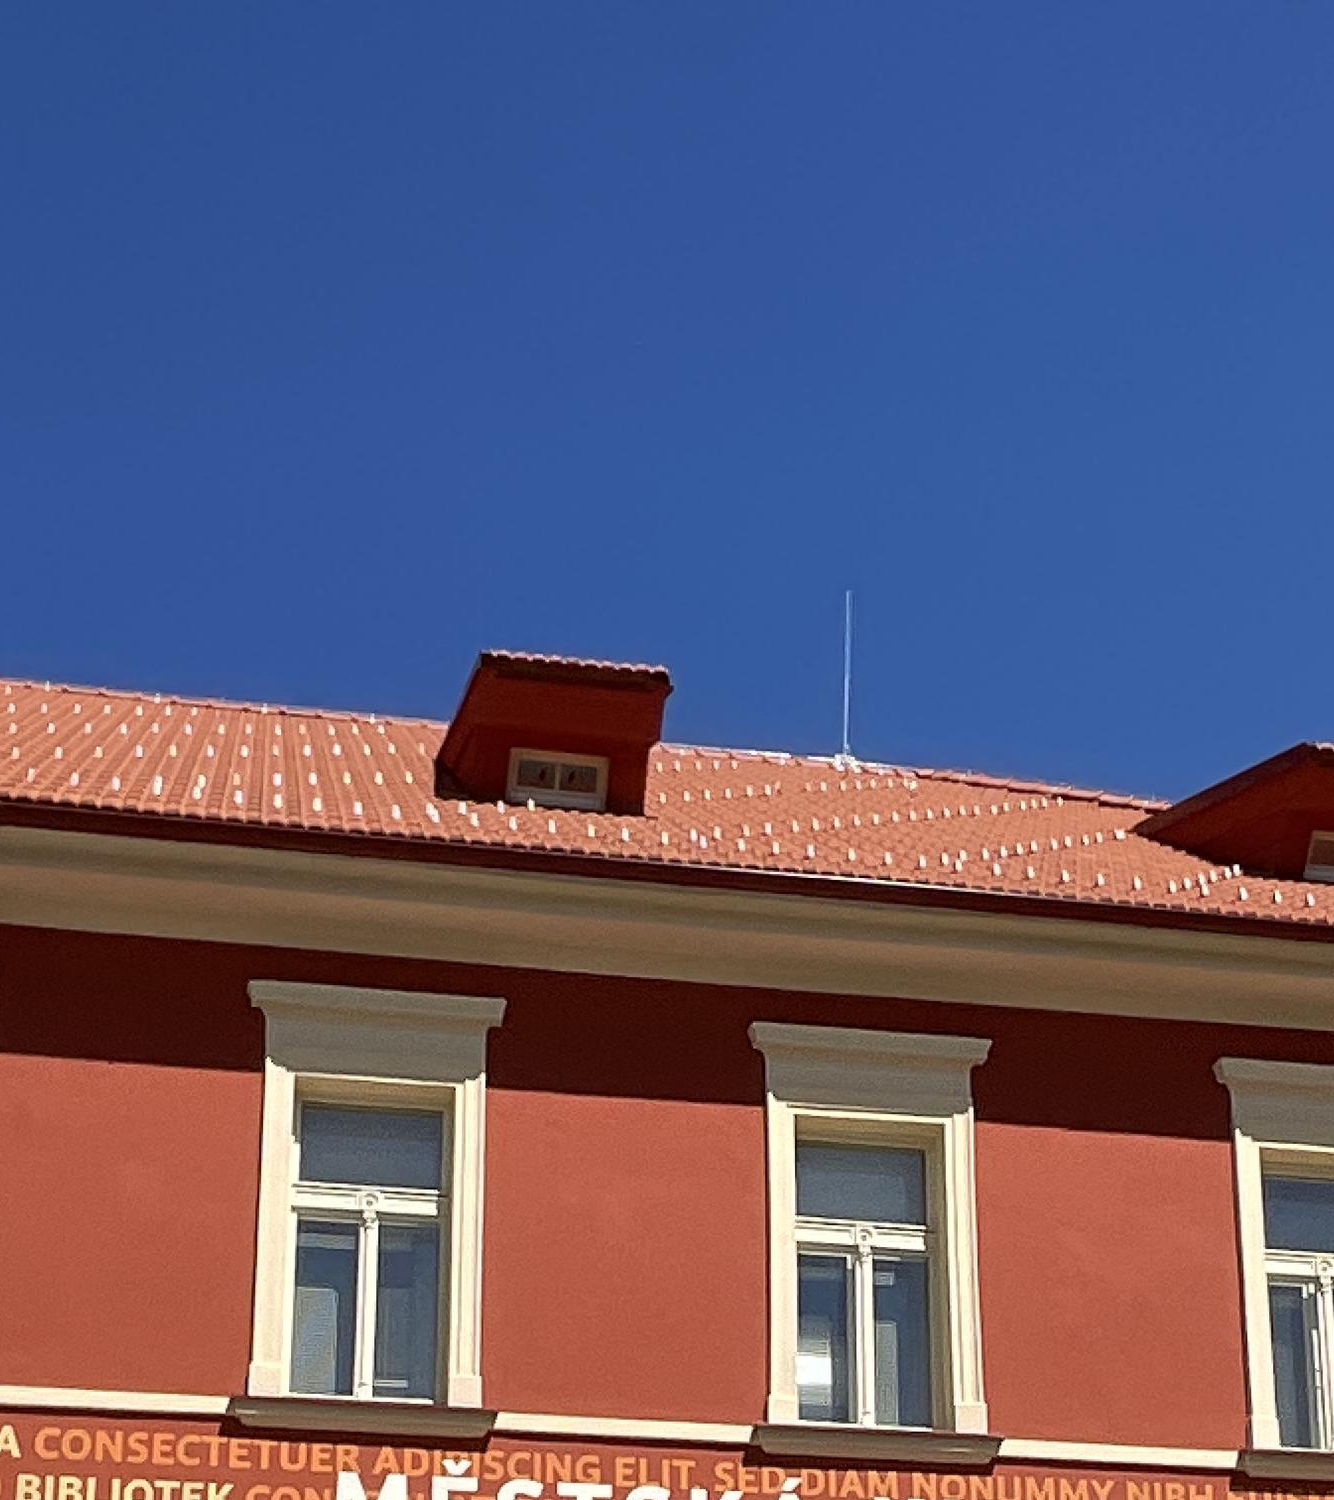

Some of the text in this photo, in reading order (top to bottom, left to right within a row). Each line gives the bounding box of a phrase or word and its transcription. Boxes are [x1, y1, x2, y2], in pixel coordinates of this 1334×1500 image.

[34, 1426, 360, 1474] CONSECTETUER
[714, 1461, 784, 1494] SED
[800, 1466, 899, 1499] DIAM
